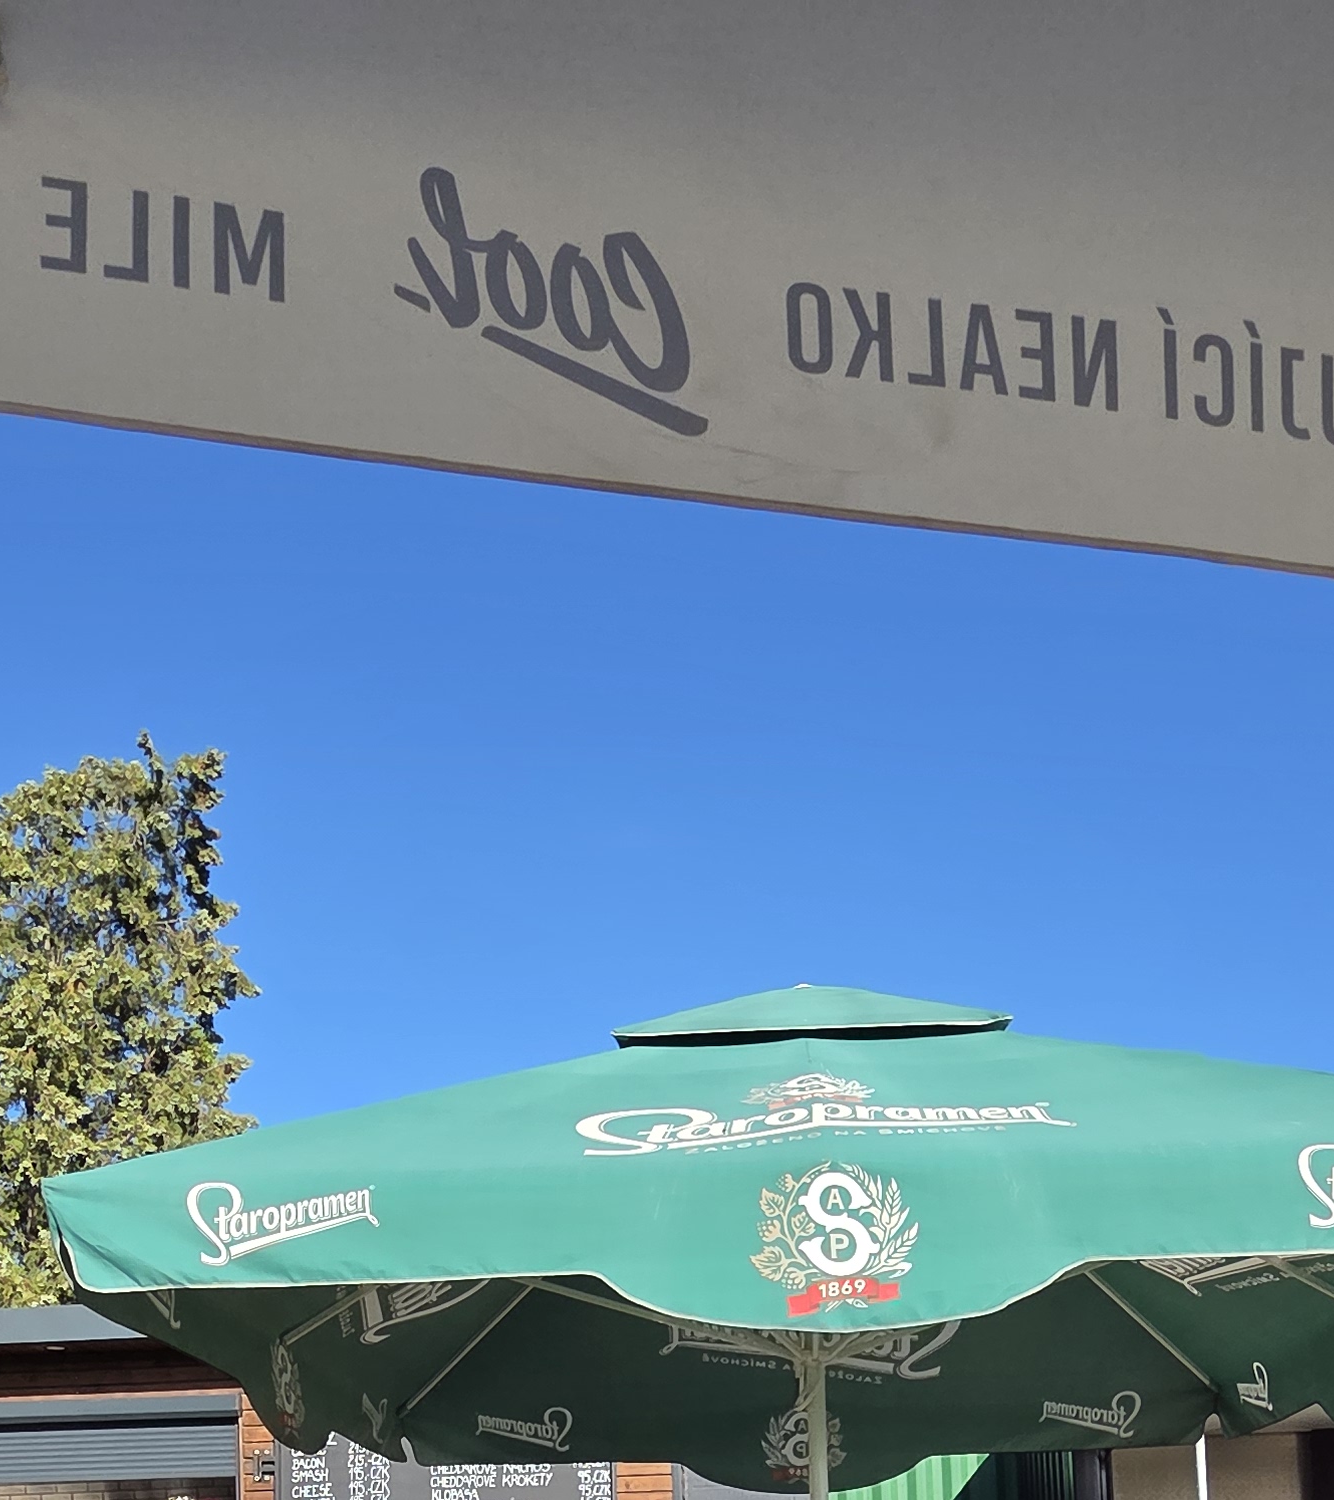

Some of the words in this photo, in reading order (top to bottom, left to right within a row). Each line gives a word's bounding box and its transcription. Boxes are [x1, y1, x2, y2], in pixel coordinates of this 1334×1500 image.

[575, 1101, 1067, 1156] Staropramen
[827, 1188, 844, 1210] A
[186, 1182, 380, 1266] Staropramen
[830, 1233, 850, 1259] P
[818, 1279, 866, 1298] 1869
[292, 1457, 326, 1470] BACON
[291, 1468, 329, 1483] SMASH
[501, 1472, 554, 1488] KROKETY
[292, 1483, 333, 1498] CHEESE
